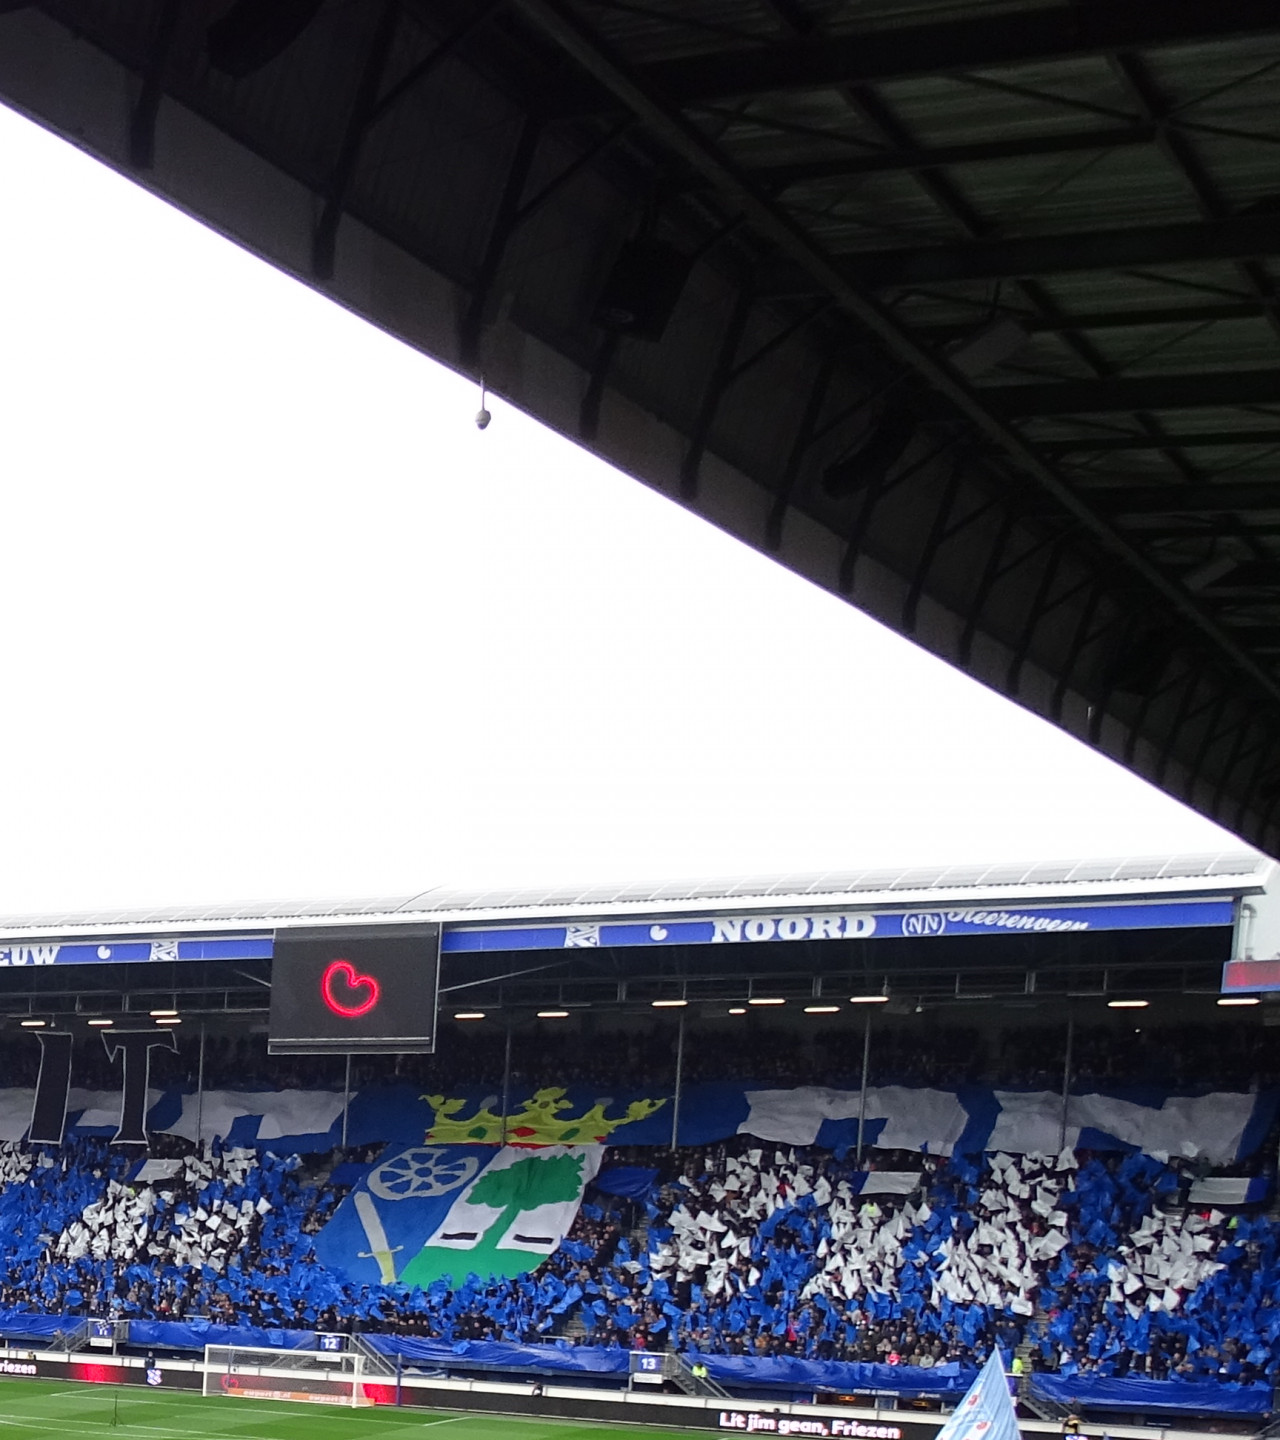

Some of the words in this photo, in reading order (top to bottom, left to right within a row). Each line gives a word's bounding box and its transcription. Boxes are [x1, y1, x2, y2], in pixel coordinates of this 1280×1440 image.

[711, 914, 877, 942] NOORD
[909, 913, 939, 936] NN
[324, 1337, 337, 1348] 12
[641, 1358, 656, 1370] 13
[719, 1412, 746, 1428] Lit
[746, 1414, 777, 1431] jim
[778, 1418, 830, 1436] gean,
[832, 1420, 903, 1440] Friezen
